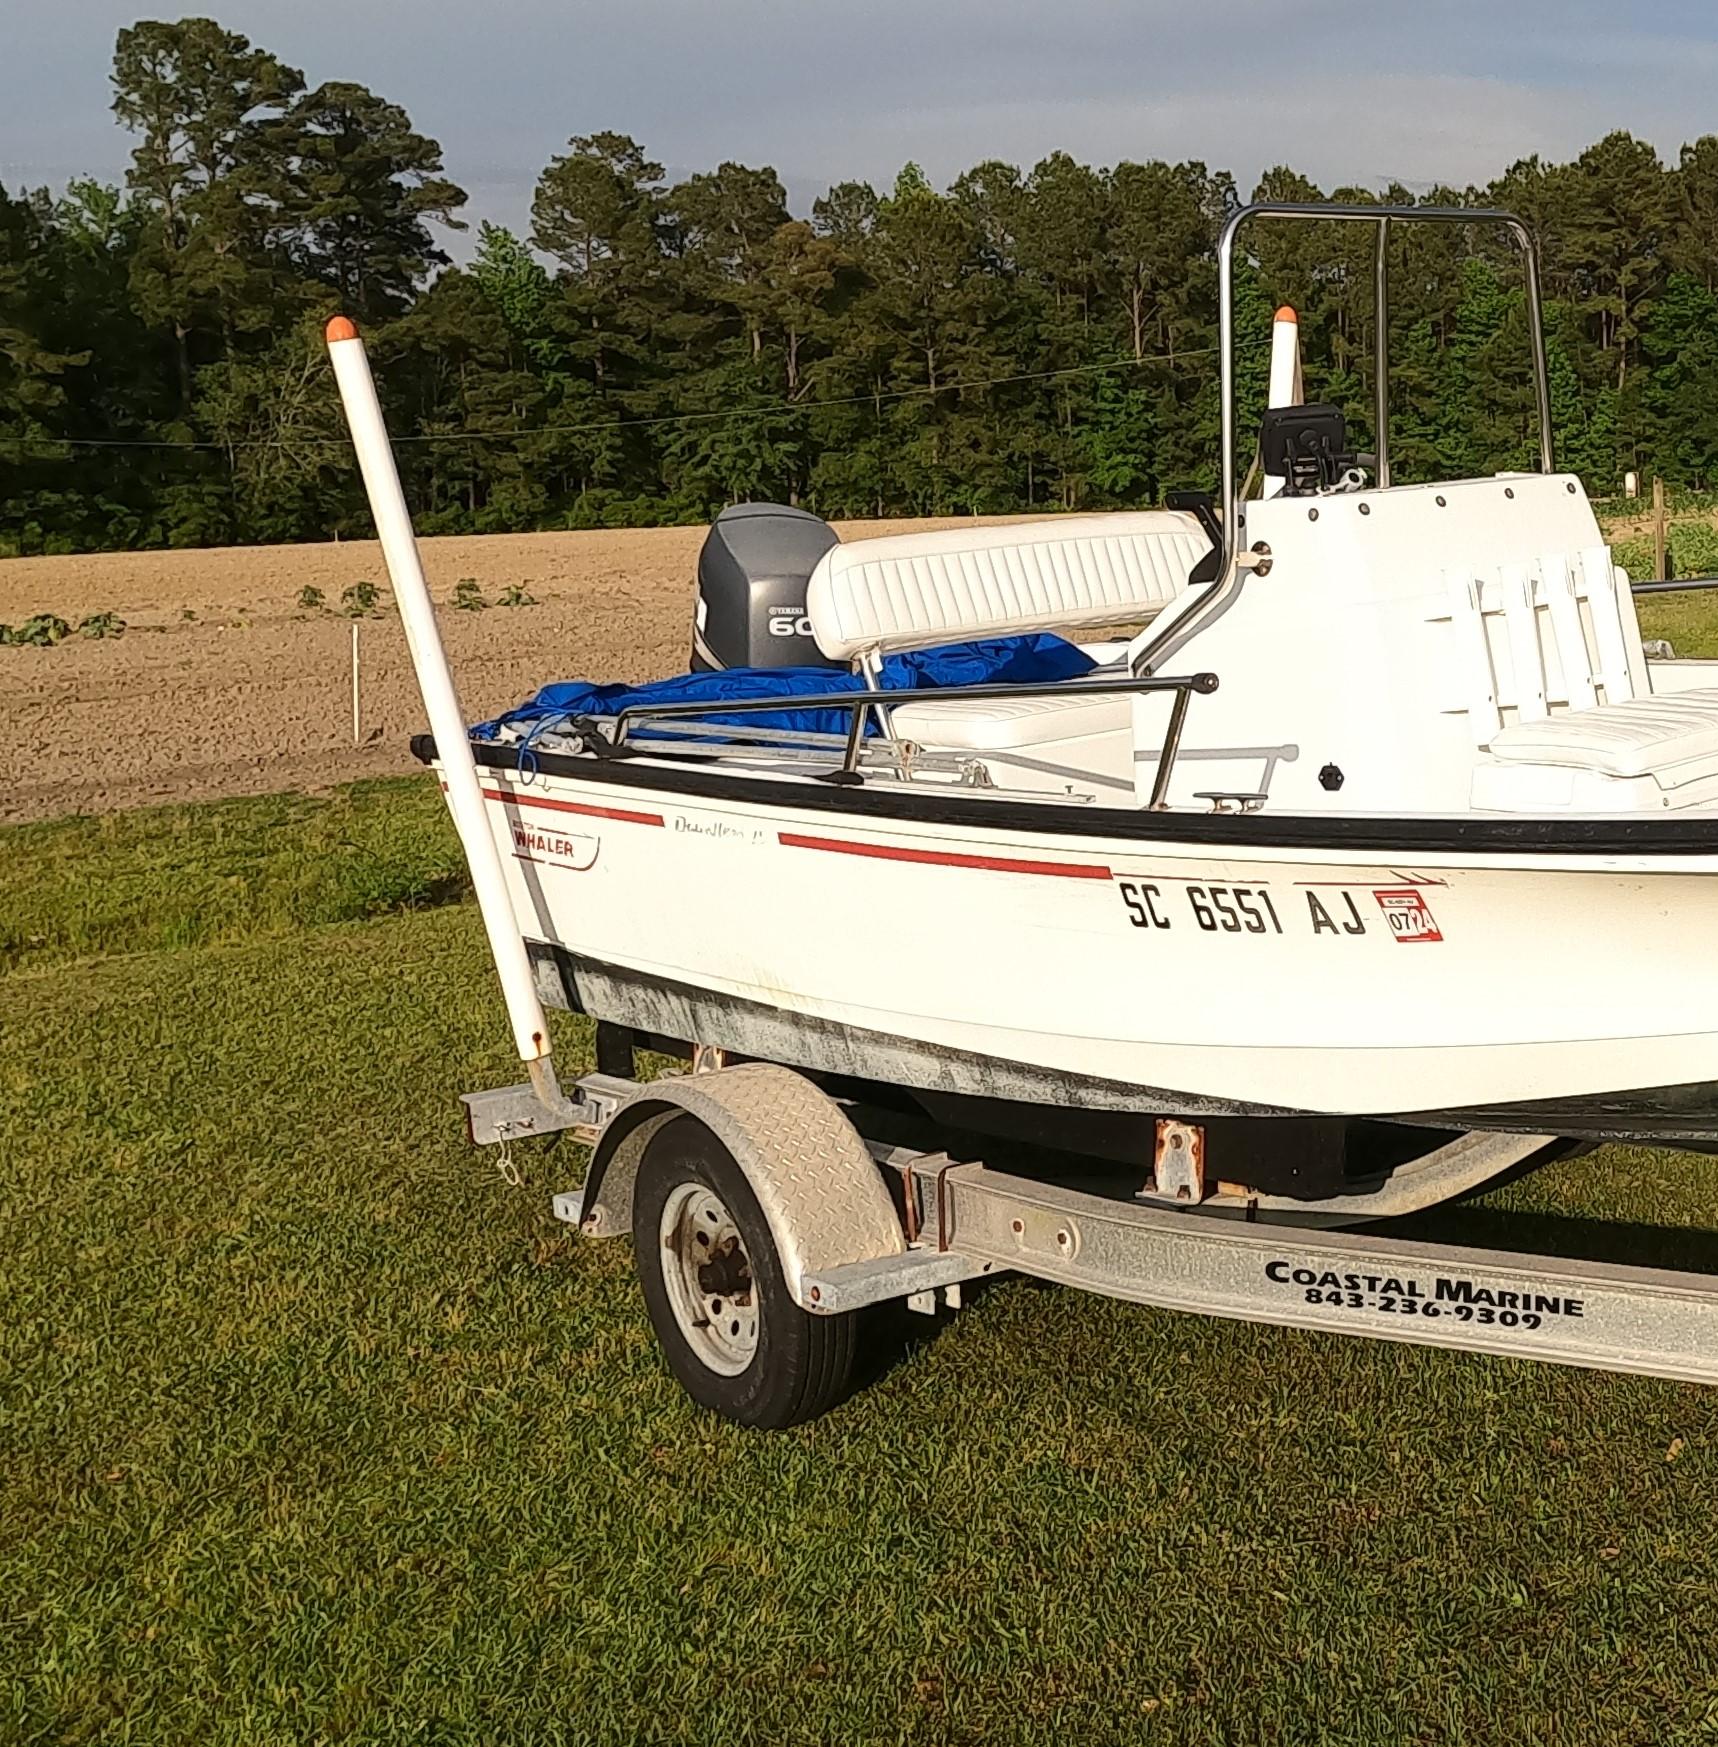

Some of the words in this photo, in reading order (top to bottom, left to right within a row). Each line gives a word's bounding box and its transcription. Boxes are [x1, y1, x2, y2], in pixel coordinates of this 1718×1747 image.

[514, 829, 574, 858] WHALER
[1119, 882, 1171, 929] SC
[1186, 886, 1283, 934] 6551
[1305, 890, 1366, 935] AJ
[1304, 1288, 1542, 1330] 843-236-9309
